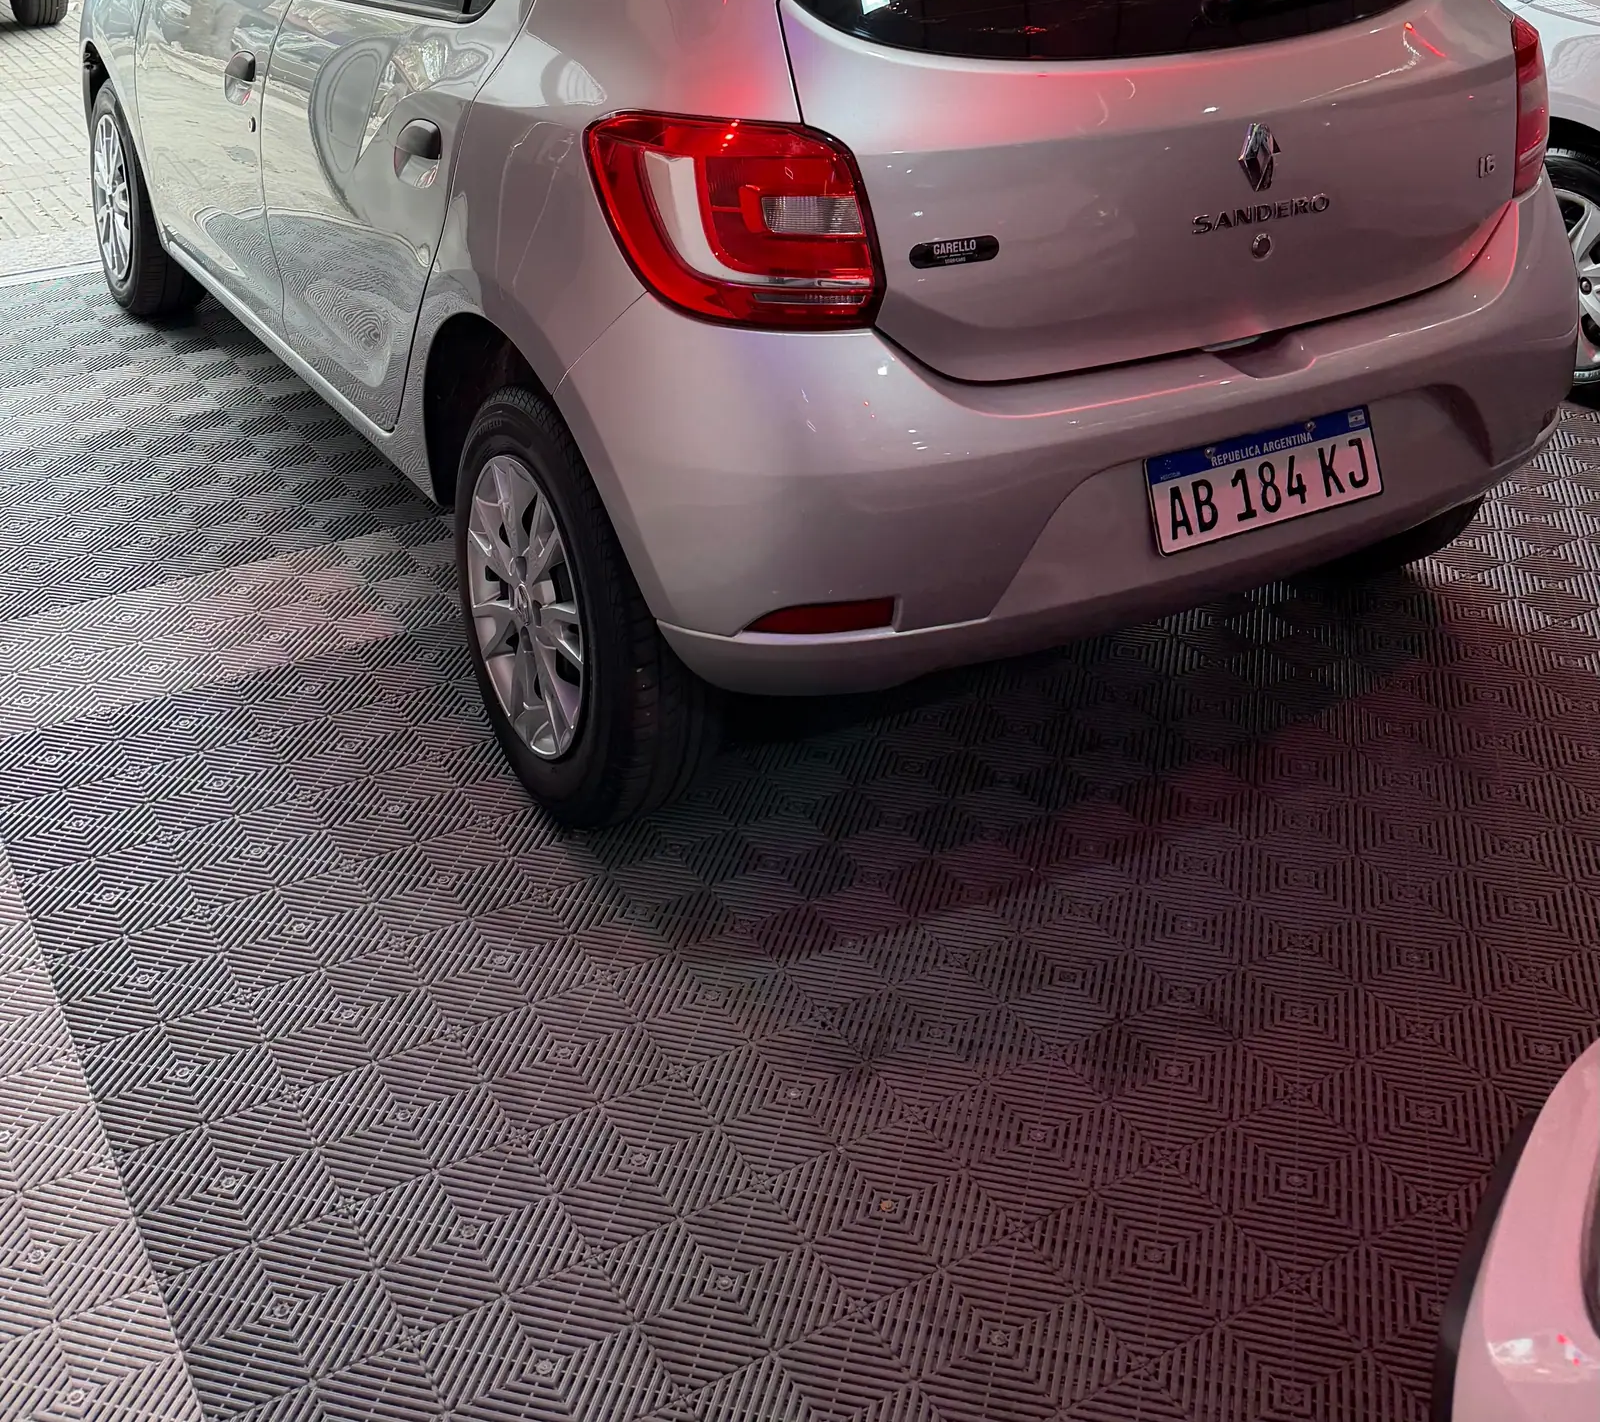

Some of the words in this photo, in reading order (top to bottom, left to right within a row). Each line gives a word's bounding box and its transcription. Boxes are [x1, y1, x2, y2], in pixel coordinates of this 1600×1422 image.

[1192, 192, 1330, 234] SANDERO
[933, 239, 977, 255] GARELLO
[1263, 431, 1313, 453] ARGENTINA
[1169, 479, 1219, 541] AB
[1230, 455, 1307, 522] 184
[1317, 437, 1370, 498] KJ
